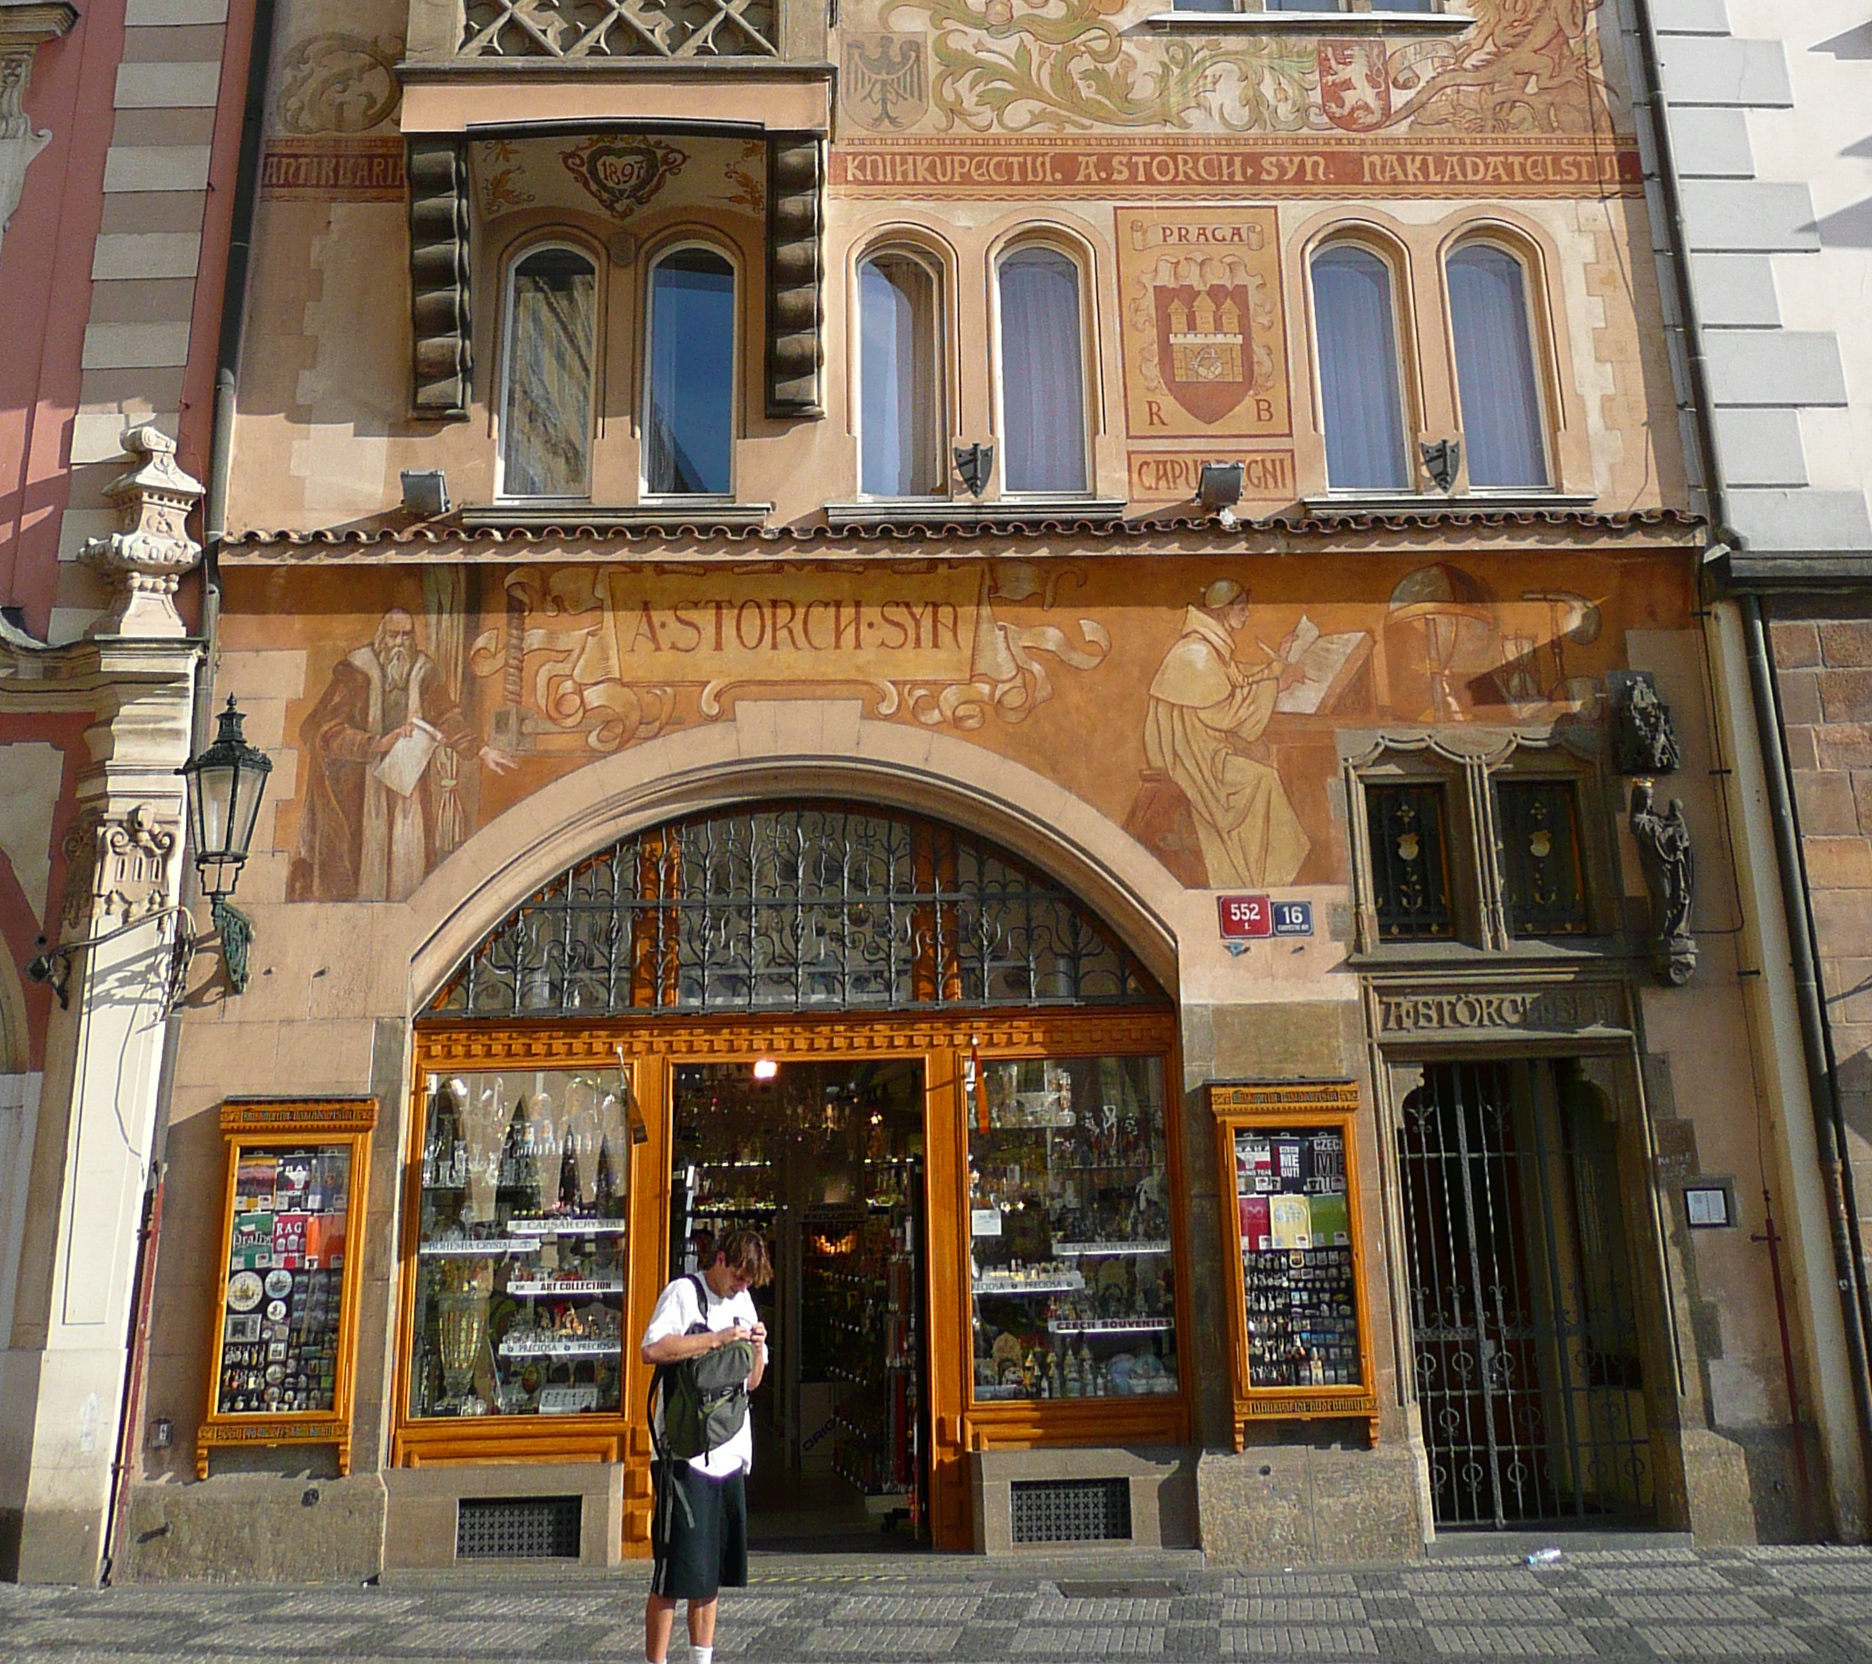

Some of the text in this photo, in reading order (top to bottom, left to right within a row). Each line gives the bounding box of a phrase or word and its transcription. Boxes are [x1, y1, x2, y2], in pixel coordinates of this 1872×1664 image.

[600, 158, 646, 186] 1897
[1160, 225, 1246, 244] PRAGA
[1146, 399, 1274, 426] R B
[1137, 458, 1212, 491] CAPU
[1231, 903, 1261, 921] 552
[1283, 906, 1303, 924] 16
[1280, 1154, 1300, 1167] ME
[275, 1221, 305, 1236] RAG
[526, 1219, 573, 1230] CAESAR
[428, 1240, 513, 1251] BOHEMIA CRYSTAL
[540, 1282, 612, 1292] ART COLLECTION
[1024, 1280, 1062, 1289] PRECIOSA
[1056, 1319, 1173, 1330] CZECH SOUVENIRS
[518, 1342, 616, 1353] PRECIOSA PRECIOSA
[802, 1418, 835, 1452] ORIG
